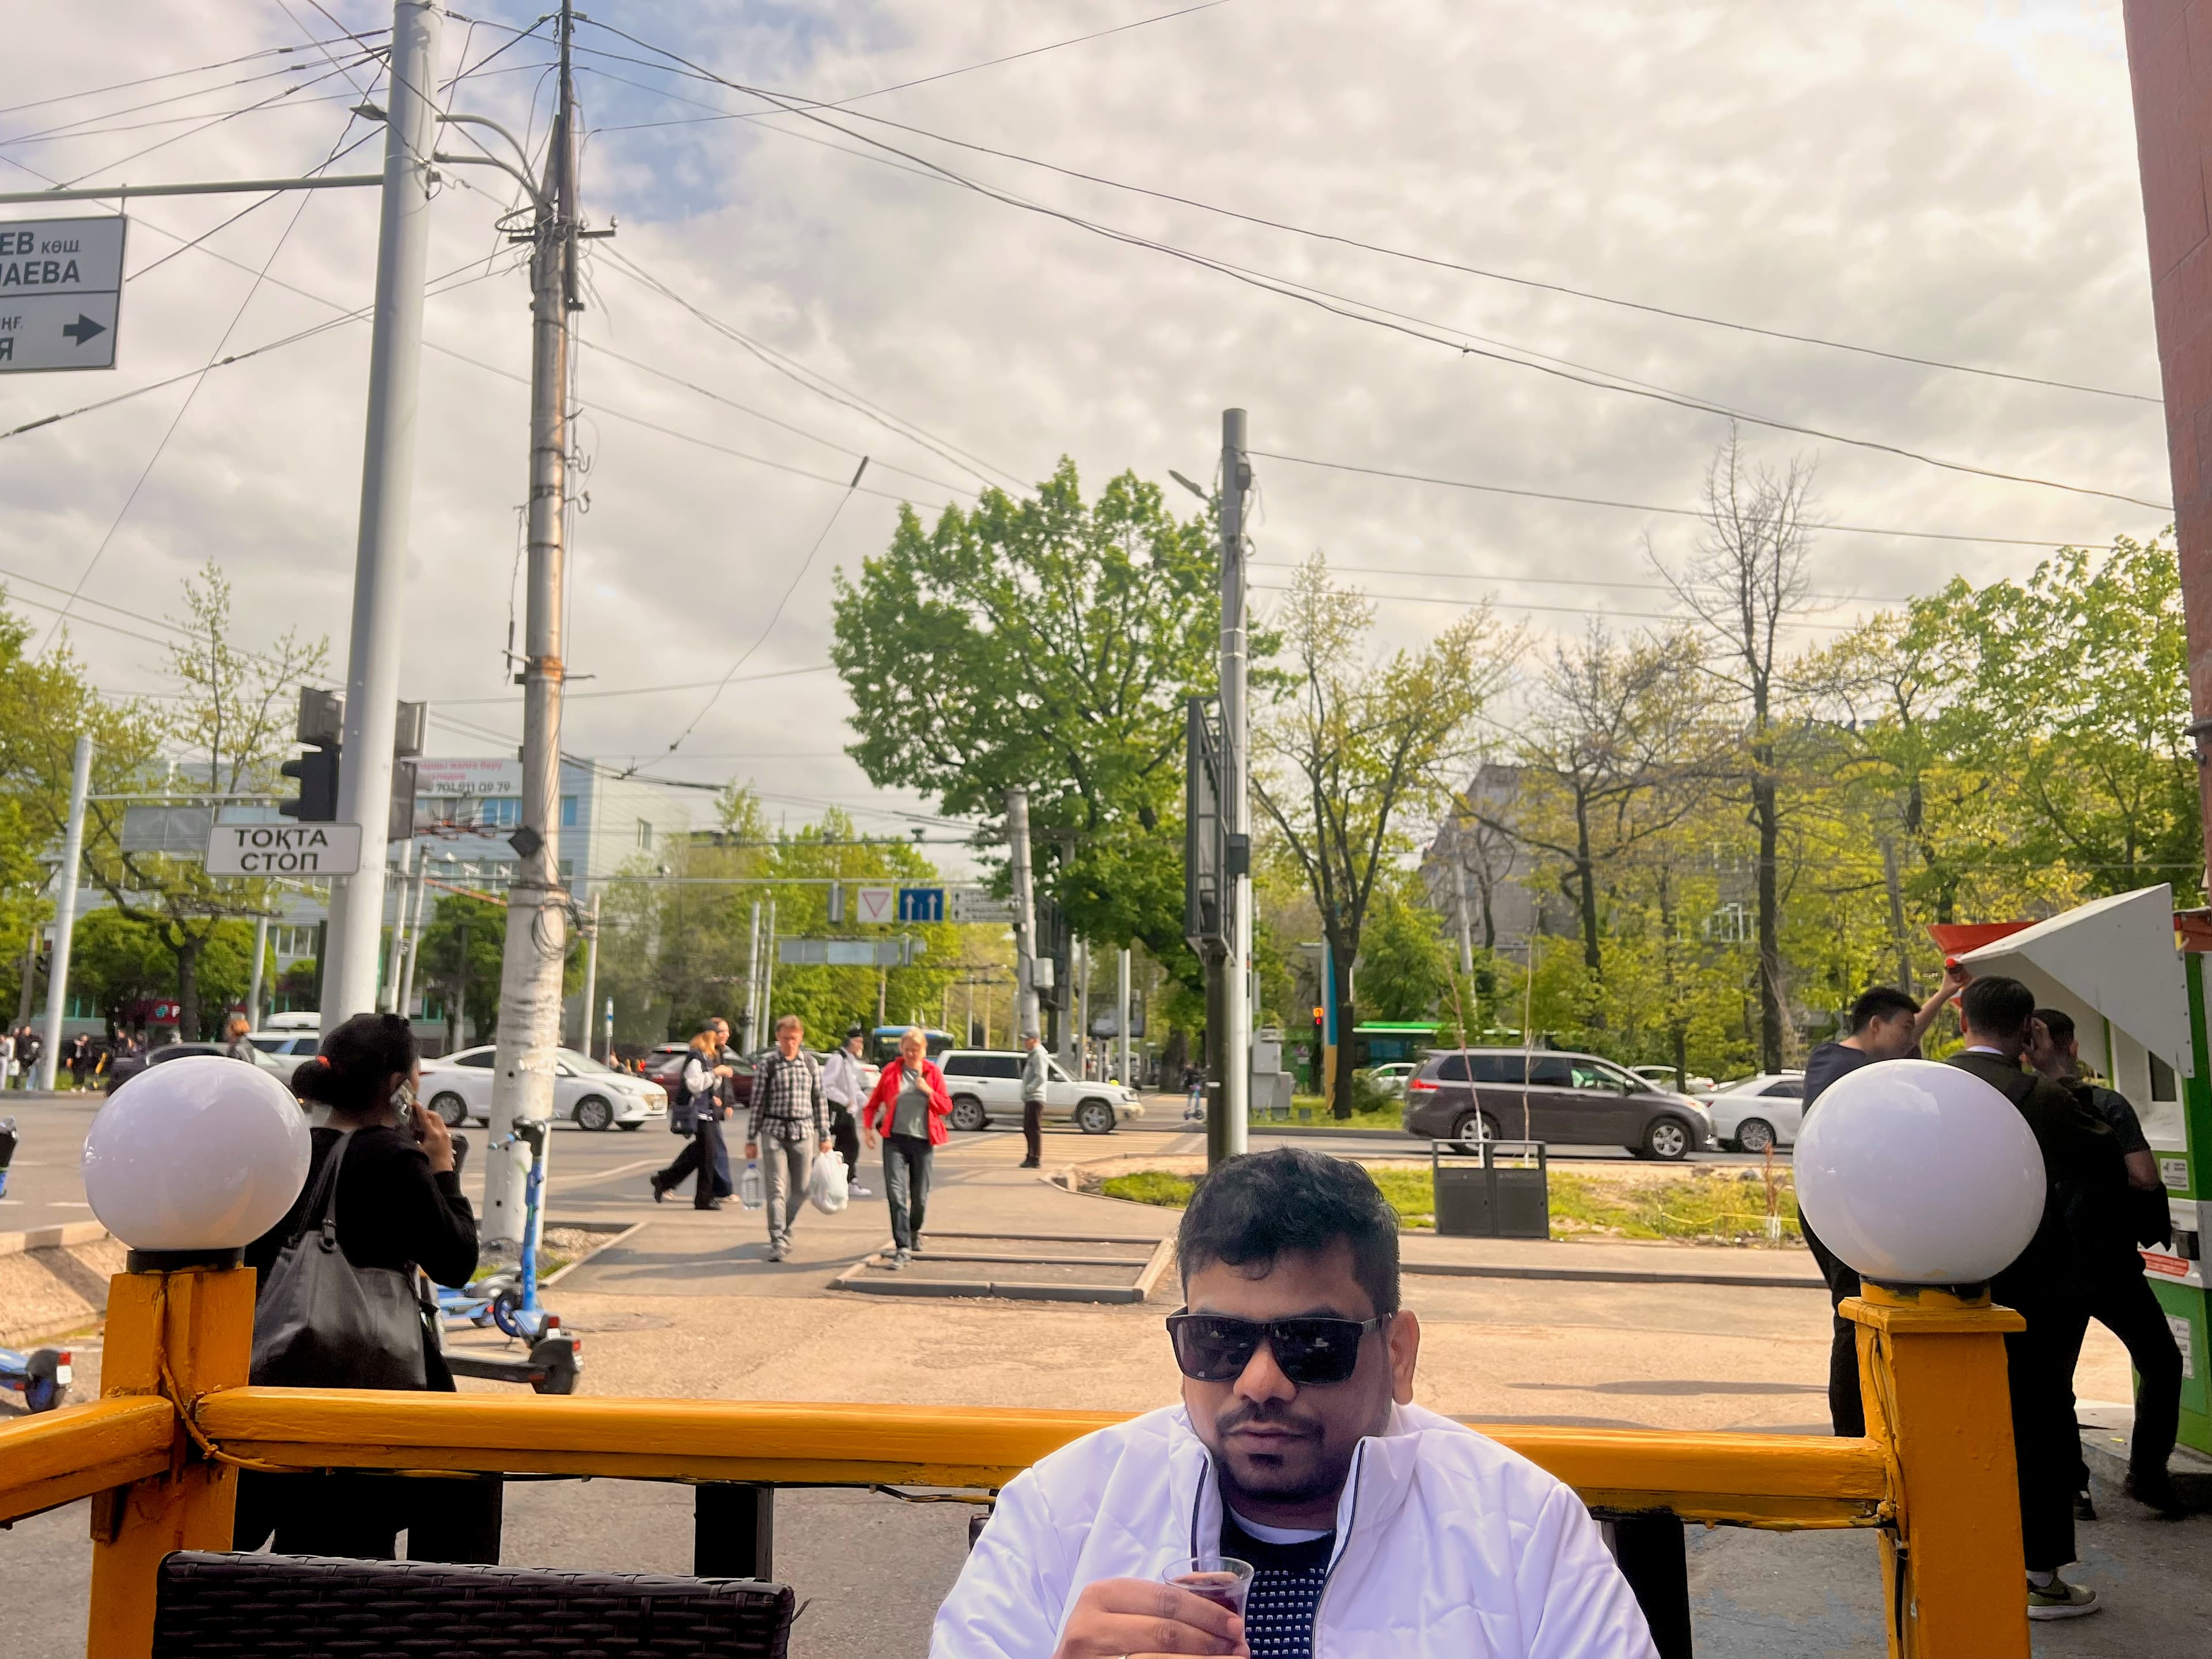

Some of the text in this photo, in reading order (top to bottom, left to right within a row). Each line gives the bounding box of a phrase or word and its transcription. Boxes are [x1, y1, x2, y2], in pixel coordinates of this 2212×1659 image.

[0, 259, 80, 286] АЕВА
[234, 828, 328, 850] ТОҚТА
[240, 852, 319, 871] СТОП
